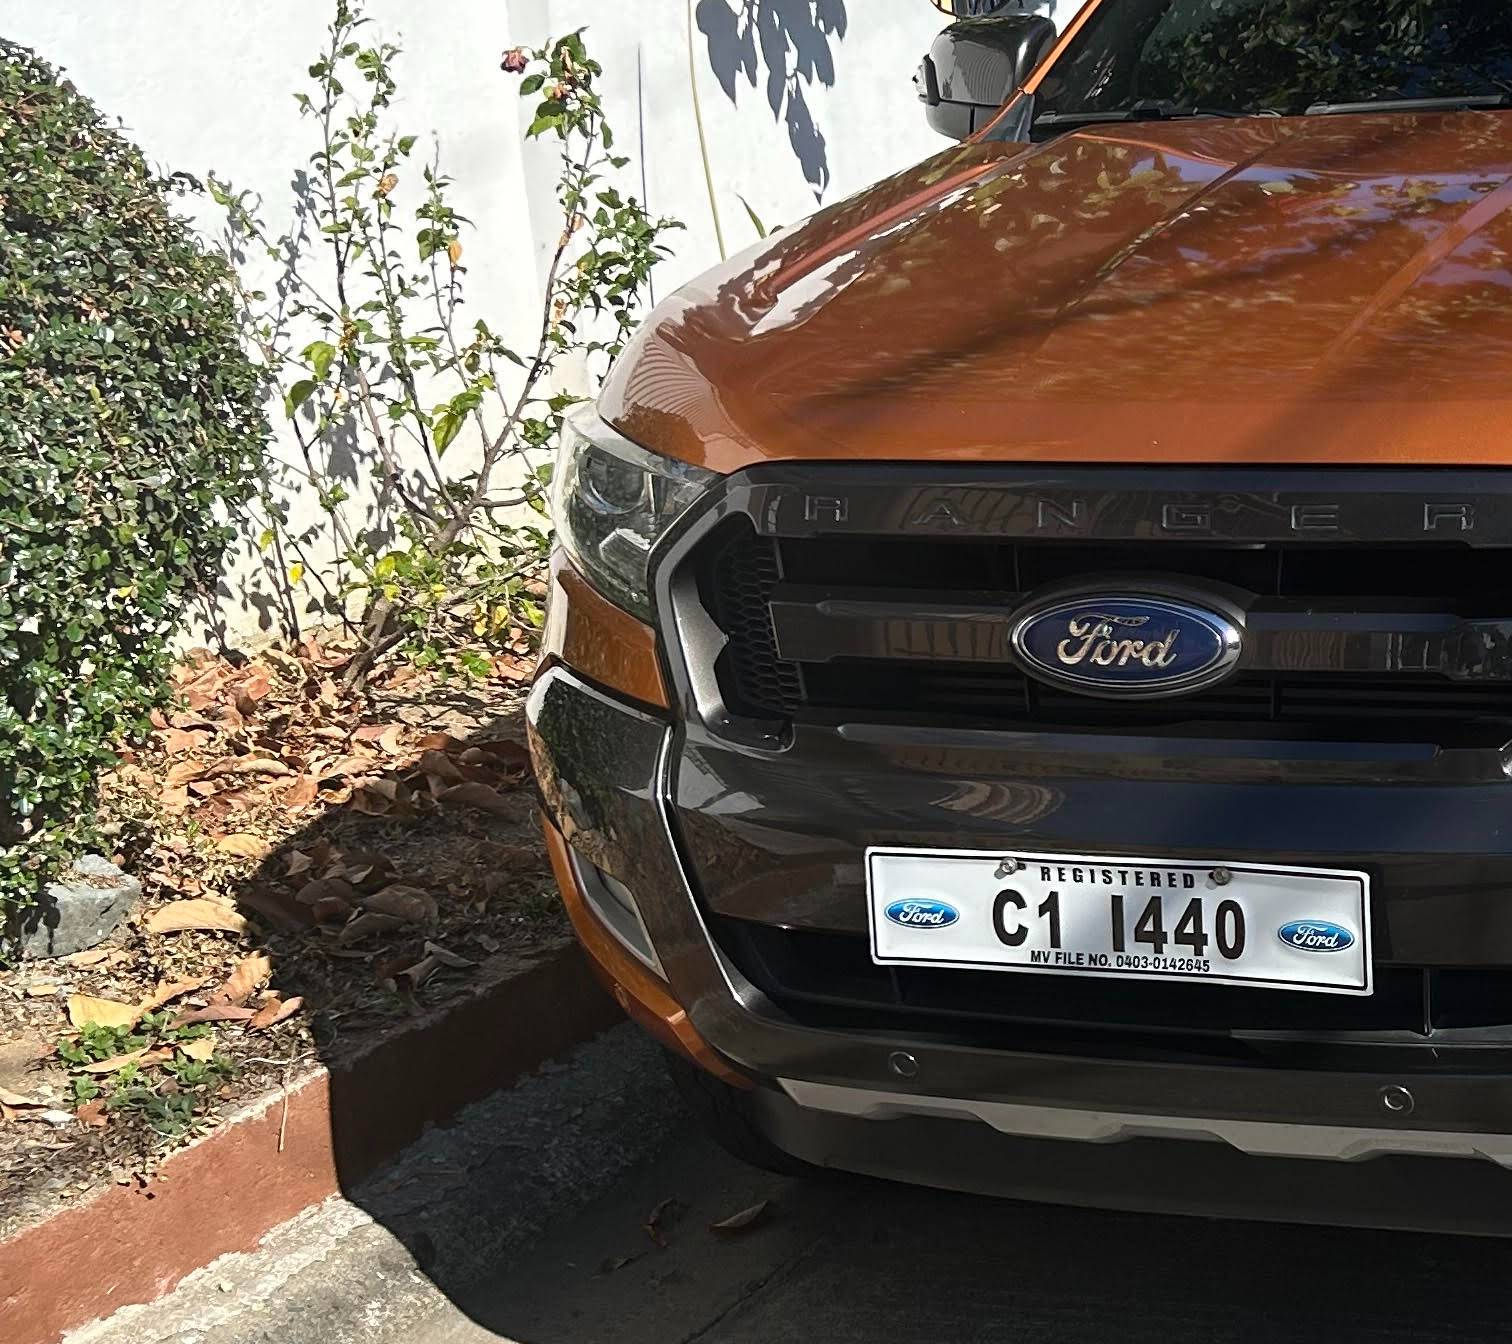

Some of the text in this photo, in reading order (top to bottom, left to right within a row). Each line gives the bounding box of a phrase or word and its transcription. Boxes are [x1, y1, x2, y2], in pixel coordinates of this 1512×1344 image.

[804, 496, 1477, 531] RANGER
[1057, 613, 1179, 667] Ford
[1041, 866, 1195, 889] REGISTERED
[899, 903, 944, 925] Ford
[992, 888, 1246, 960] C1 1440
[1293, 927, 1340, 948] Ford
[1030, 950, 1210, 972] MV FILE NO. 0403-0142645
